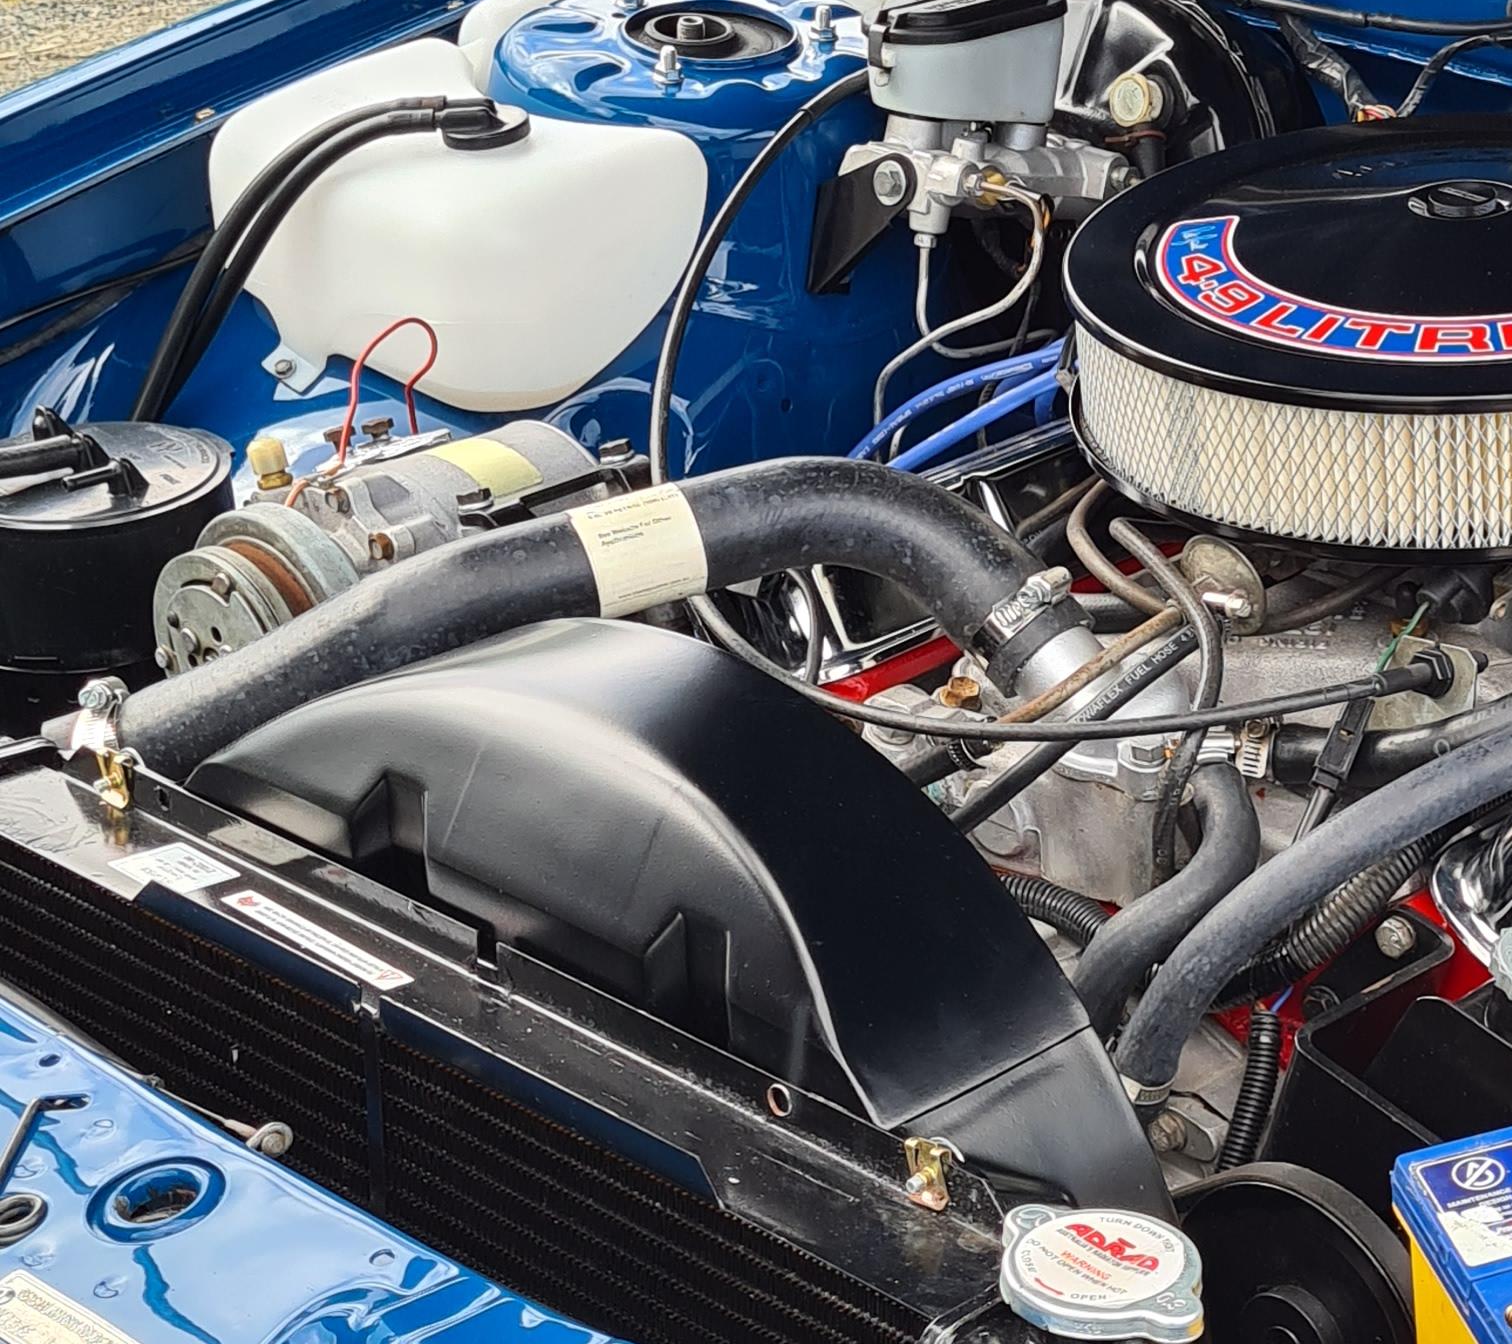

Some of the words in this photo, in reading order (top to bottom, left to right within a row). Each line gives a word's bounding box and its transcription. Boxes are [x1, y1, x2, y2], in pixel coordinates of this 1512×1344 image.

[1125, 663, 1153, 686] FUEL
[1151, 641, 1179, 665] HOSE
[1445, 1186, 1512, 1209] MAINTENANCE
[1064, 1222, 1162, 1272] ADRAD
[1056, 1257, 1082, 1277] OPEN
[1060, 1249, 1114, 1282] WARNING
[1070, 1293, 1108, 1302] OPEN
